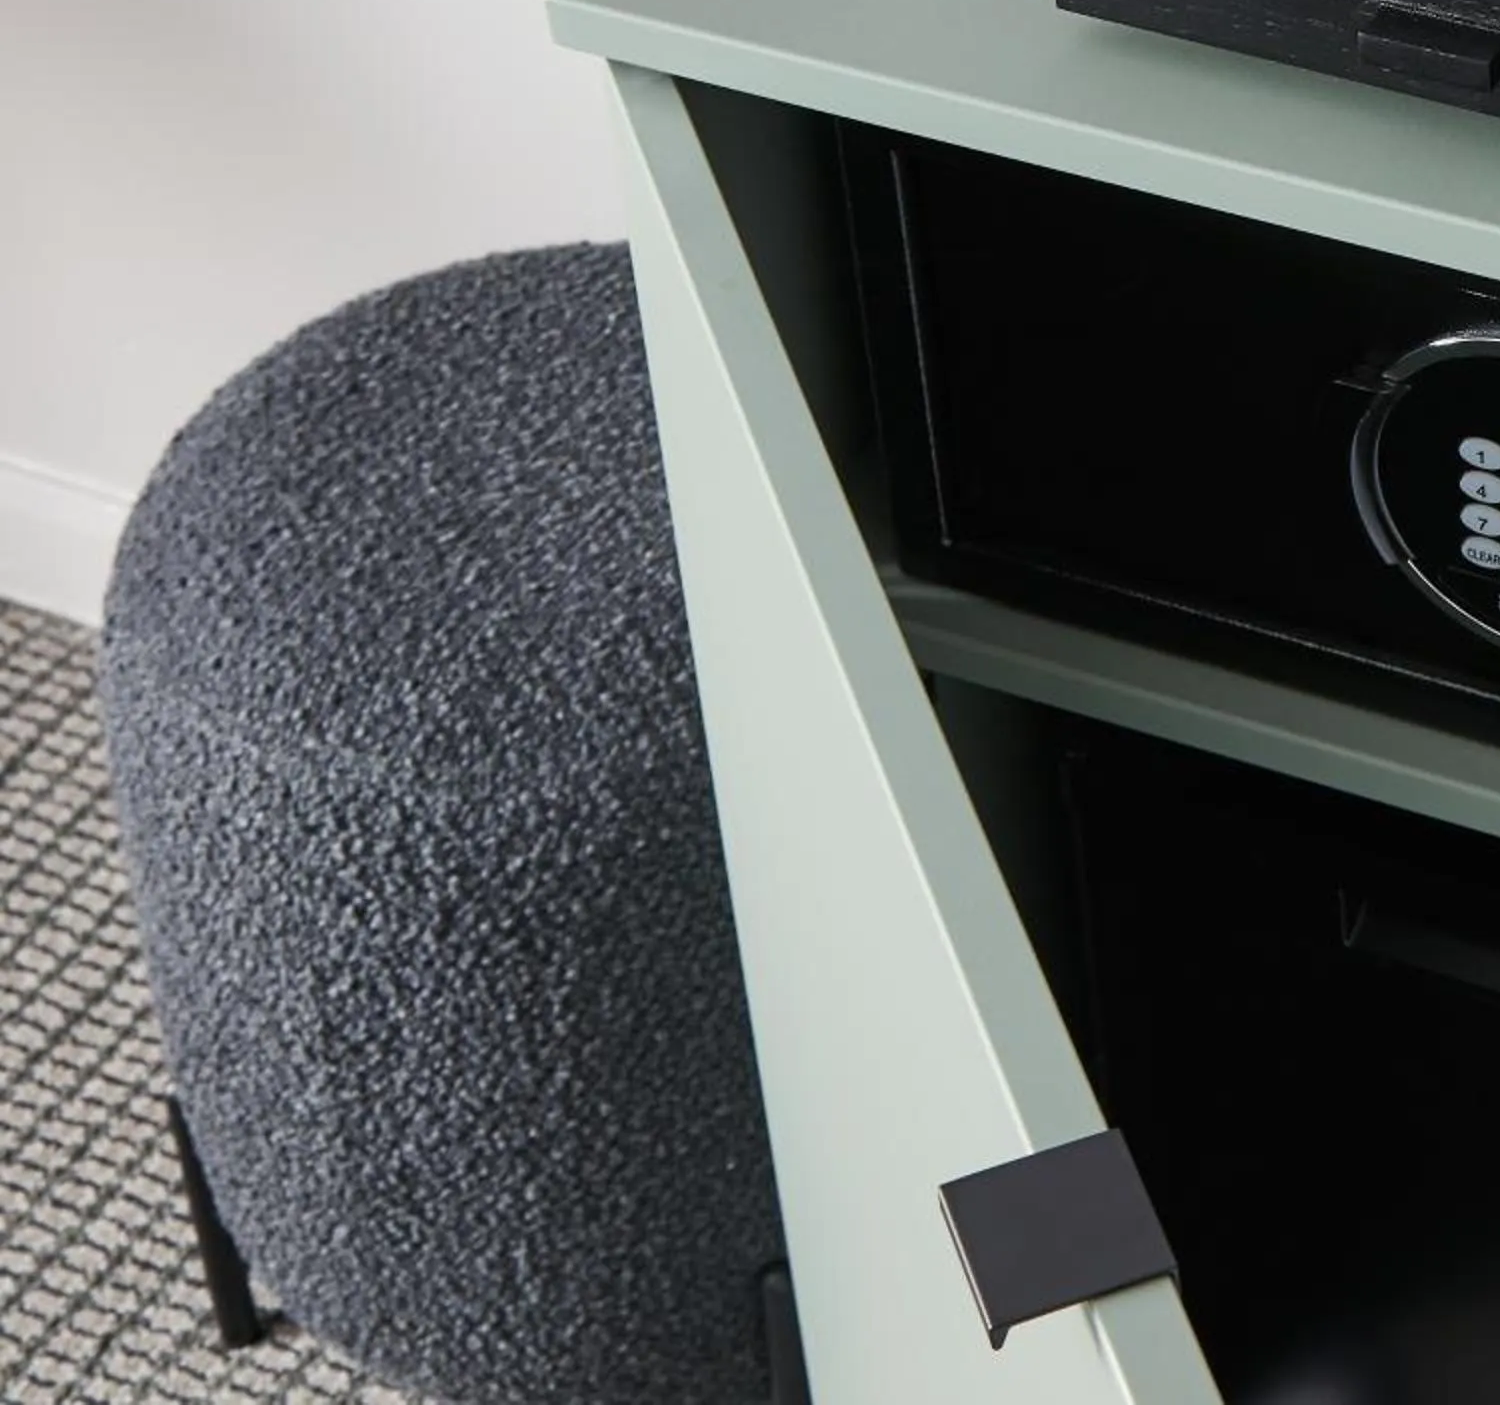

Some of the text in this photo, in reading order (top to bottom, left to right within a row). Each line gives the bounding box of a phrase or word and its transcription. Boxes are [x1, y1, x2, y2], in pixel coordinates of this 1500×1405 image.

[1476, 451, 1485, 464] 1
[1476, 485, 1486, 498] 4
[1477, 518, 1488, 531] 7
